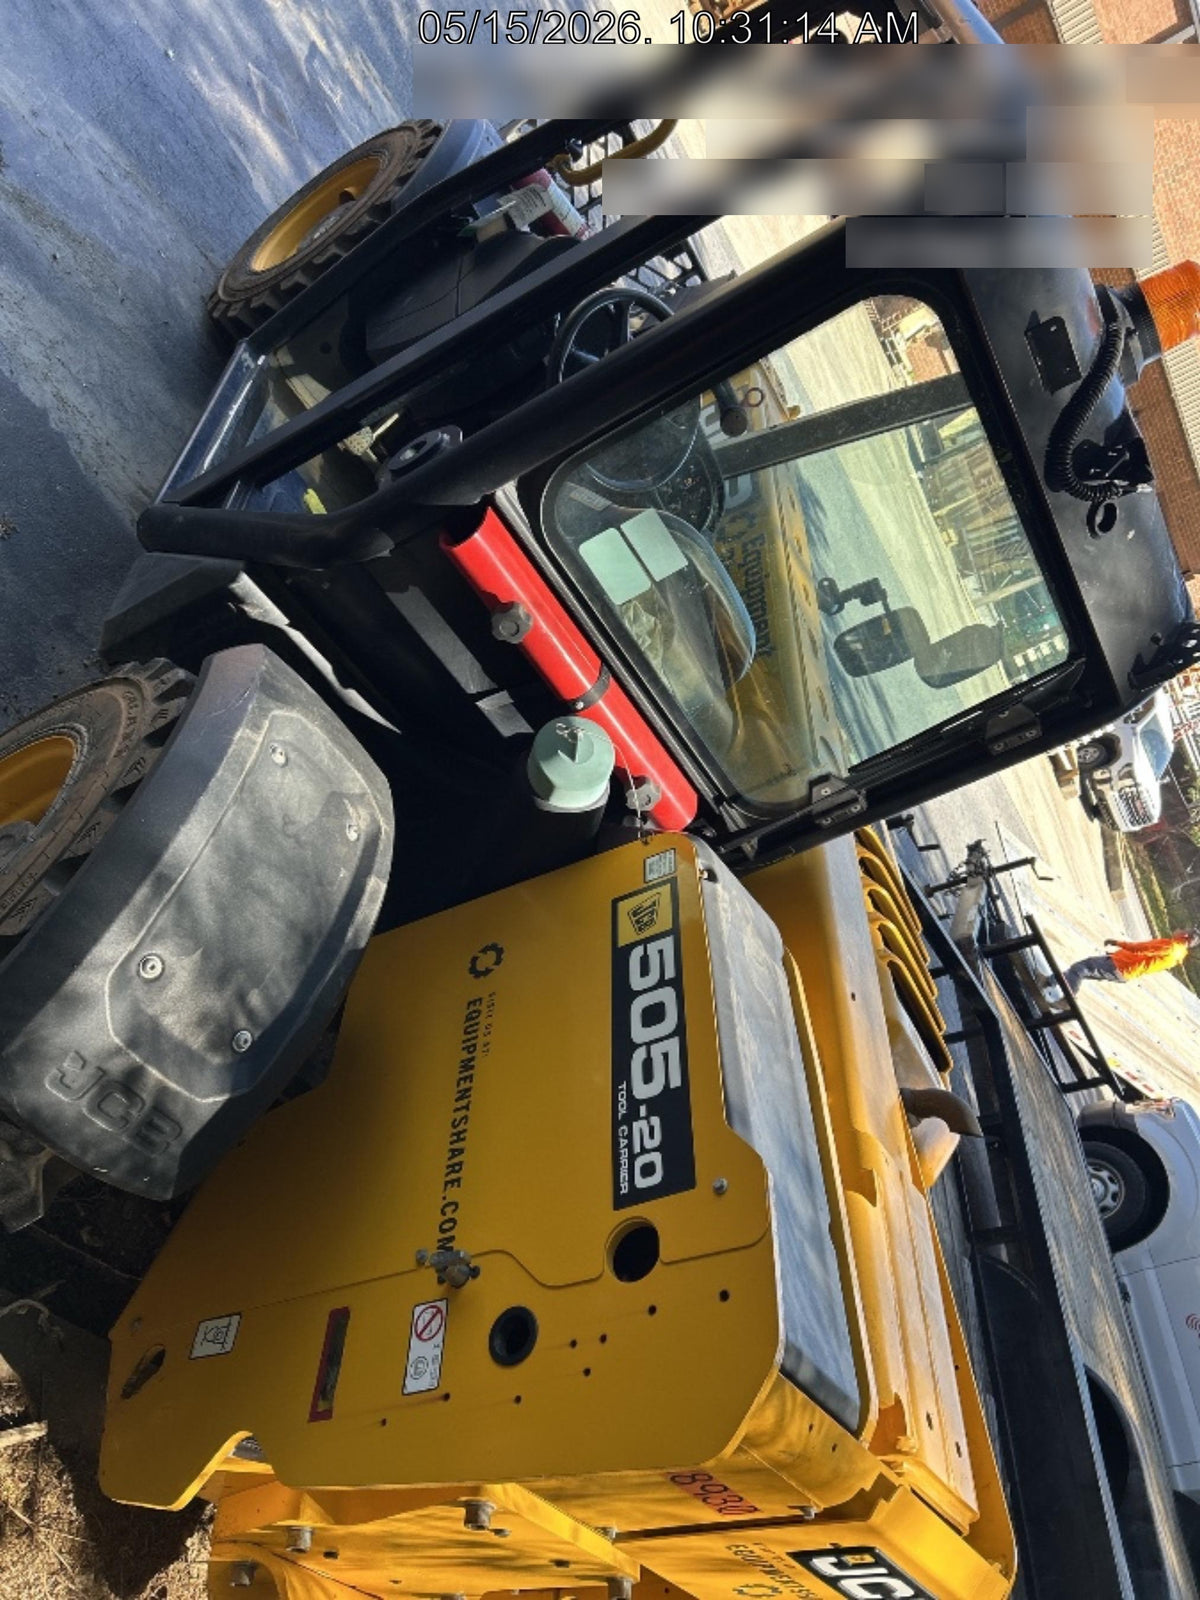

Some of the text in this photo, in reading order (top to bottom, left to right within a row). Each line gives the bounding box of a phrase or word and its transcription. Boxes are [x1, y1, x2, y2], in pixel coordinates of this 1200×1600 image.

[740, 534, 774, 656] Equipment
[629, 897, 661, 935] JCB
[44, 1051, 183, 1154] JCB
[629, 935, 682, 1189] 505-20
[618, 1081, 628, 1195] TOOL CARRIER
